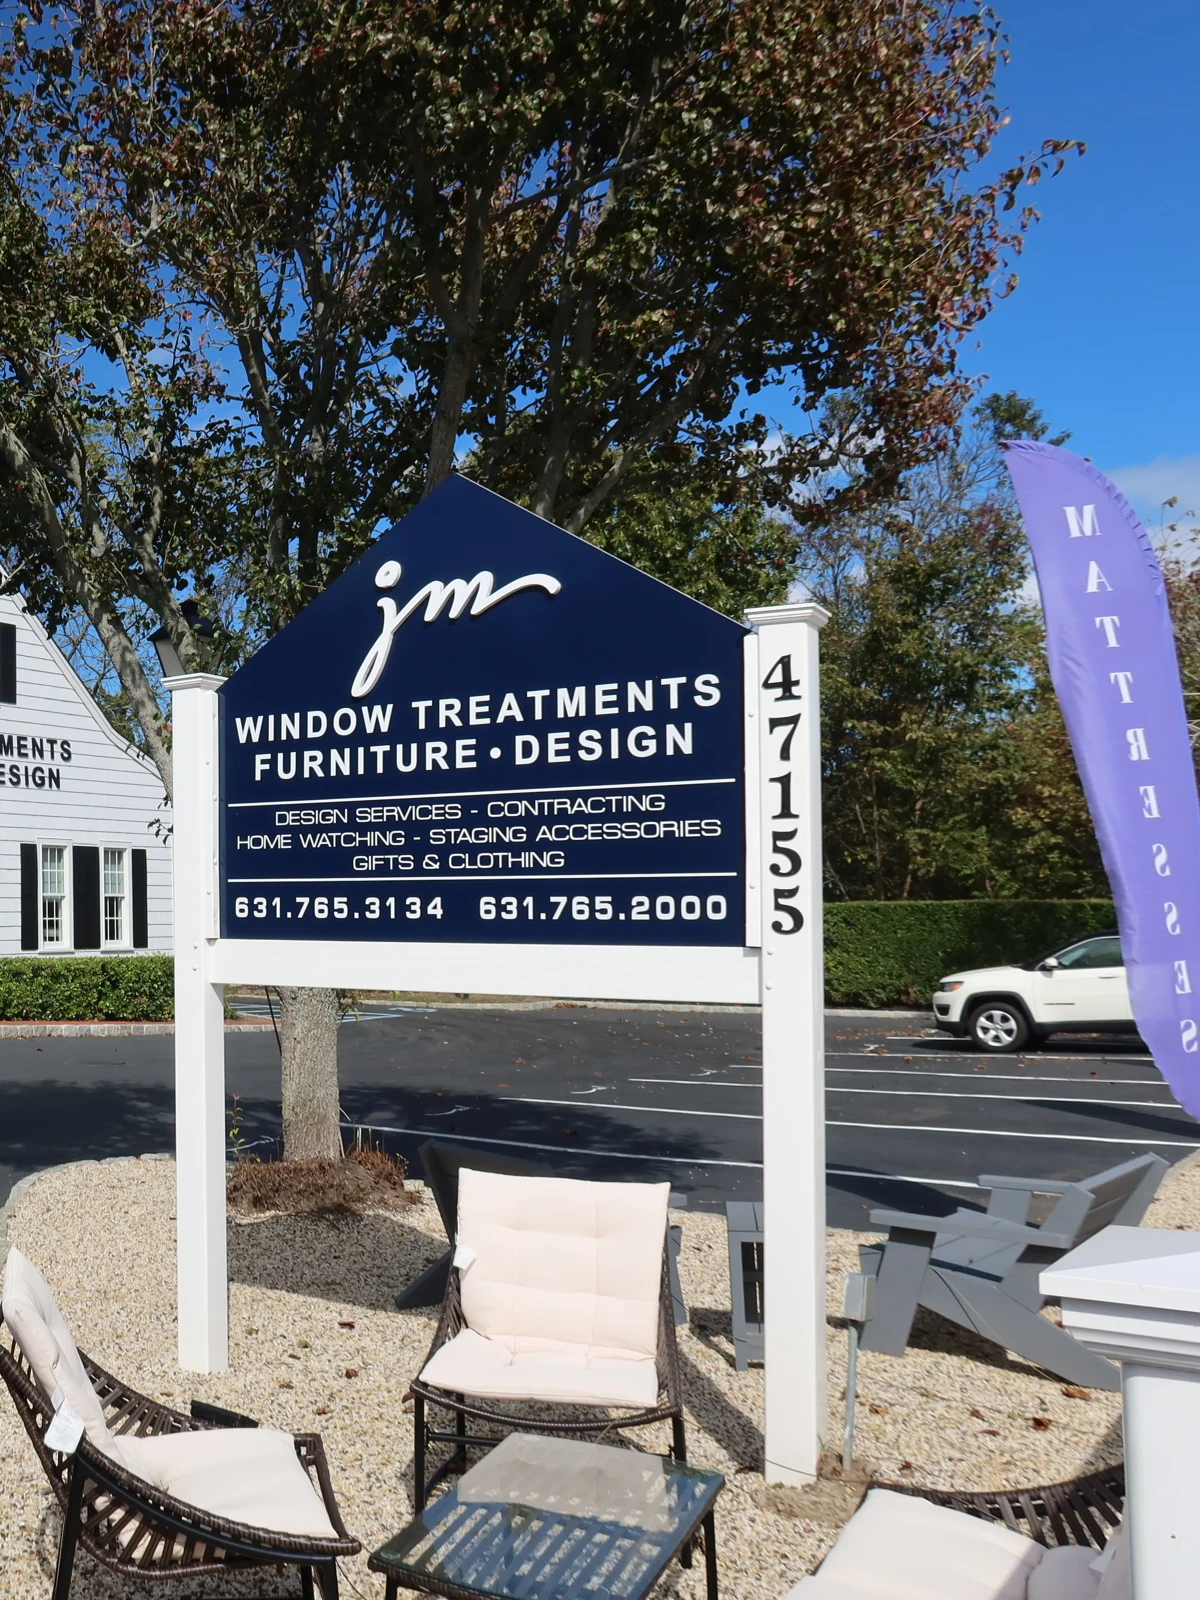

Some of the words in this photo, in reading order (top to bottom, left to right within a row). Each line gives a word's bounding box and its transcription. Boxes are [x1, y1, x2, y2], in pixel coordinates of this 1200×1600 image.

[234, 703, 394, 744] WINDOW
[411, 672, 722, 731] TREATMENTS
[253, 738, 478, 782] FURNITURE
[514, 722, 694, 766] DESIGN
[275, 808, 349, 826] DESIGN
[355, 803, 462, 823] SERVICES
[486, 793, 666, 818] CONTRACTING
[760, 653, 804, 936] 47155
[236, 833, 292, 850] HOME
[299, 830, 405, 849] WATCHING
[428, 826, 527, 845] STAGING
[535, 818, 722, 842] ACCESSORIES
[352, 853, 414, 871] GIFTS
[422, 853, 440, 870] &
[448, 850, 565, 869] CLOTHING
[235, 895, 444, 920] 631.765.3134
[479, 894, 728, 921] 631.765.2000
